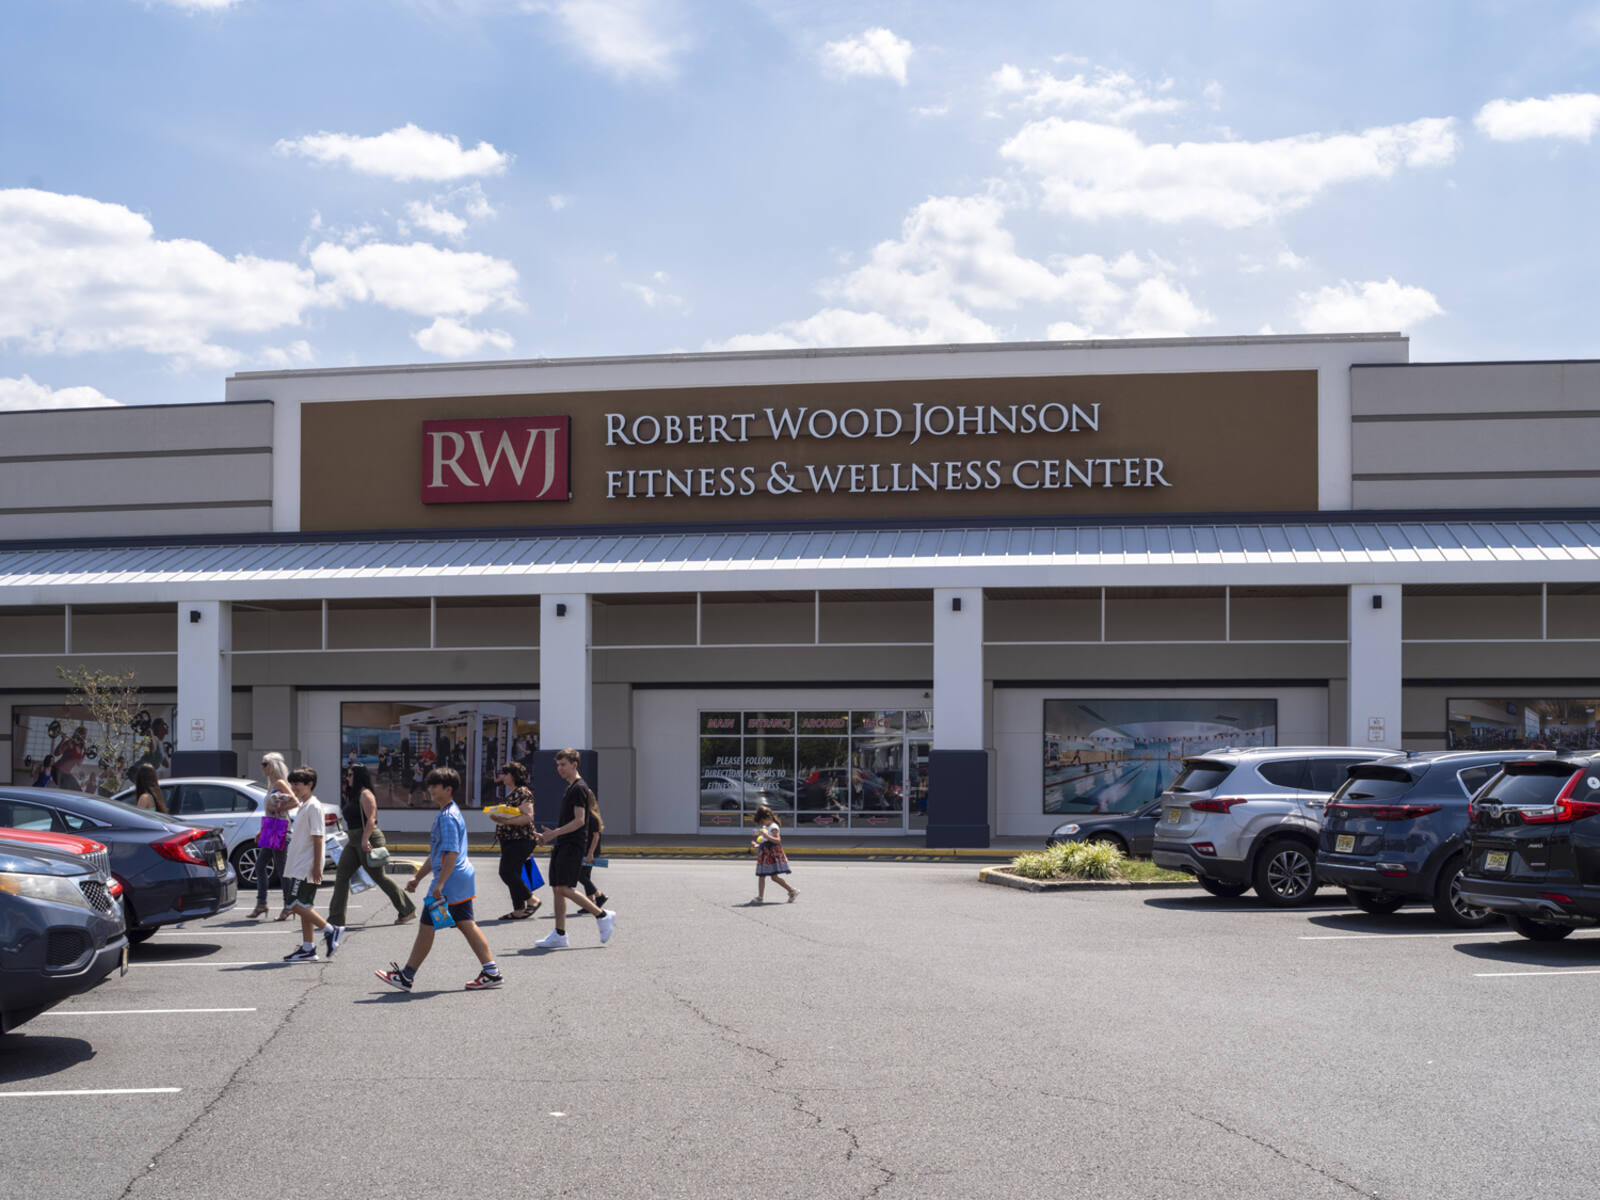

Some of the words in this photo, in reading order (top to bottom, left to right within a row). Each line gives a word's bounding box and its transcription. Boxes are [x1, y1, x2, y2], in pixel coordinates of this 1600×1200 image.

[605, 413, 755, 447] ROBERT
[763, 407, 903, 441] WOOD
[910, 402, 1101, 445] JOHNSON
[427, 428, 560, 498] RWJ
[605, 467, 756, 499] FITNESS
[766, 461, 802, 495] &
[805, 460, 1000, 494] WELLNESS
[1012, 458, 1173, 489] CENTER
[707, 718, 735, 729] MAIN
[748, 718, 792, 729] ENTRANCE
[802, 718, 846, 729] AROUND
[716, 756, 741, 765] PLEASE
[745, 756, 774, 765] FOLLOW
